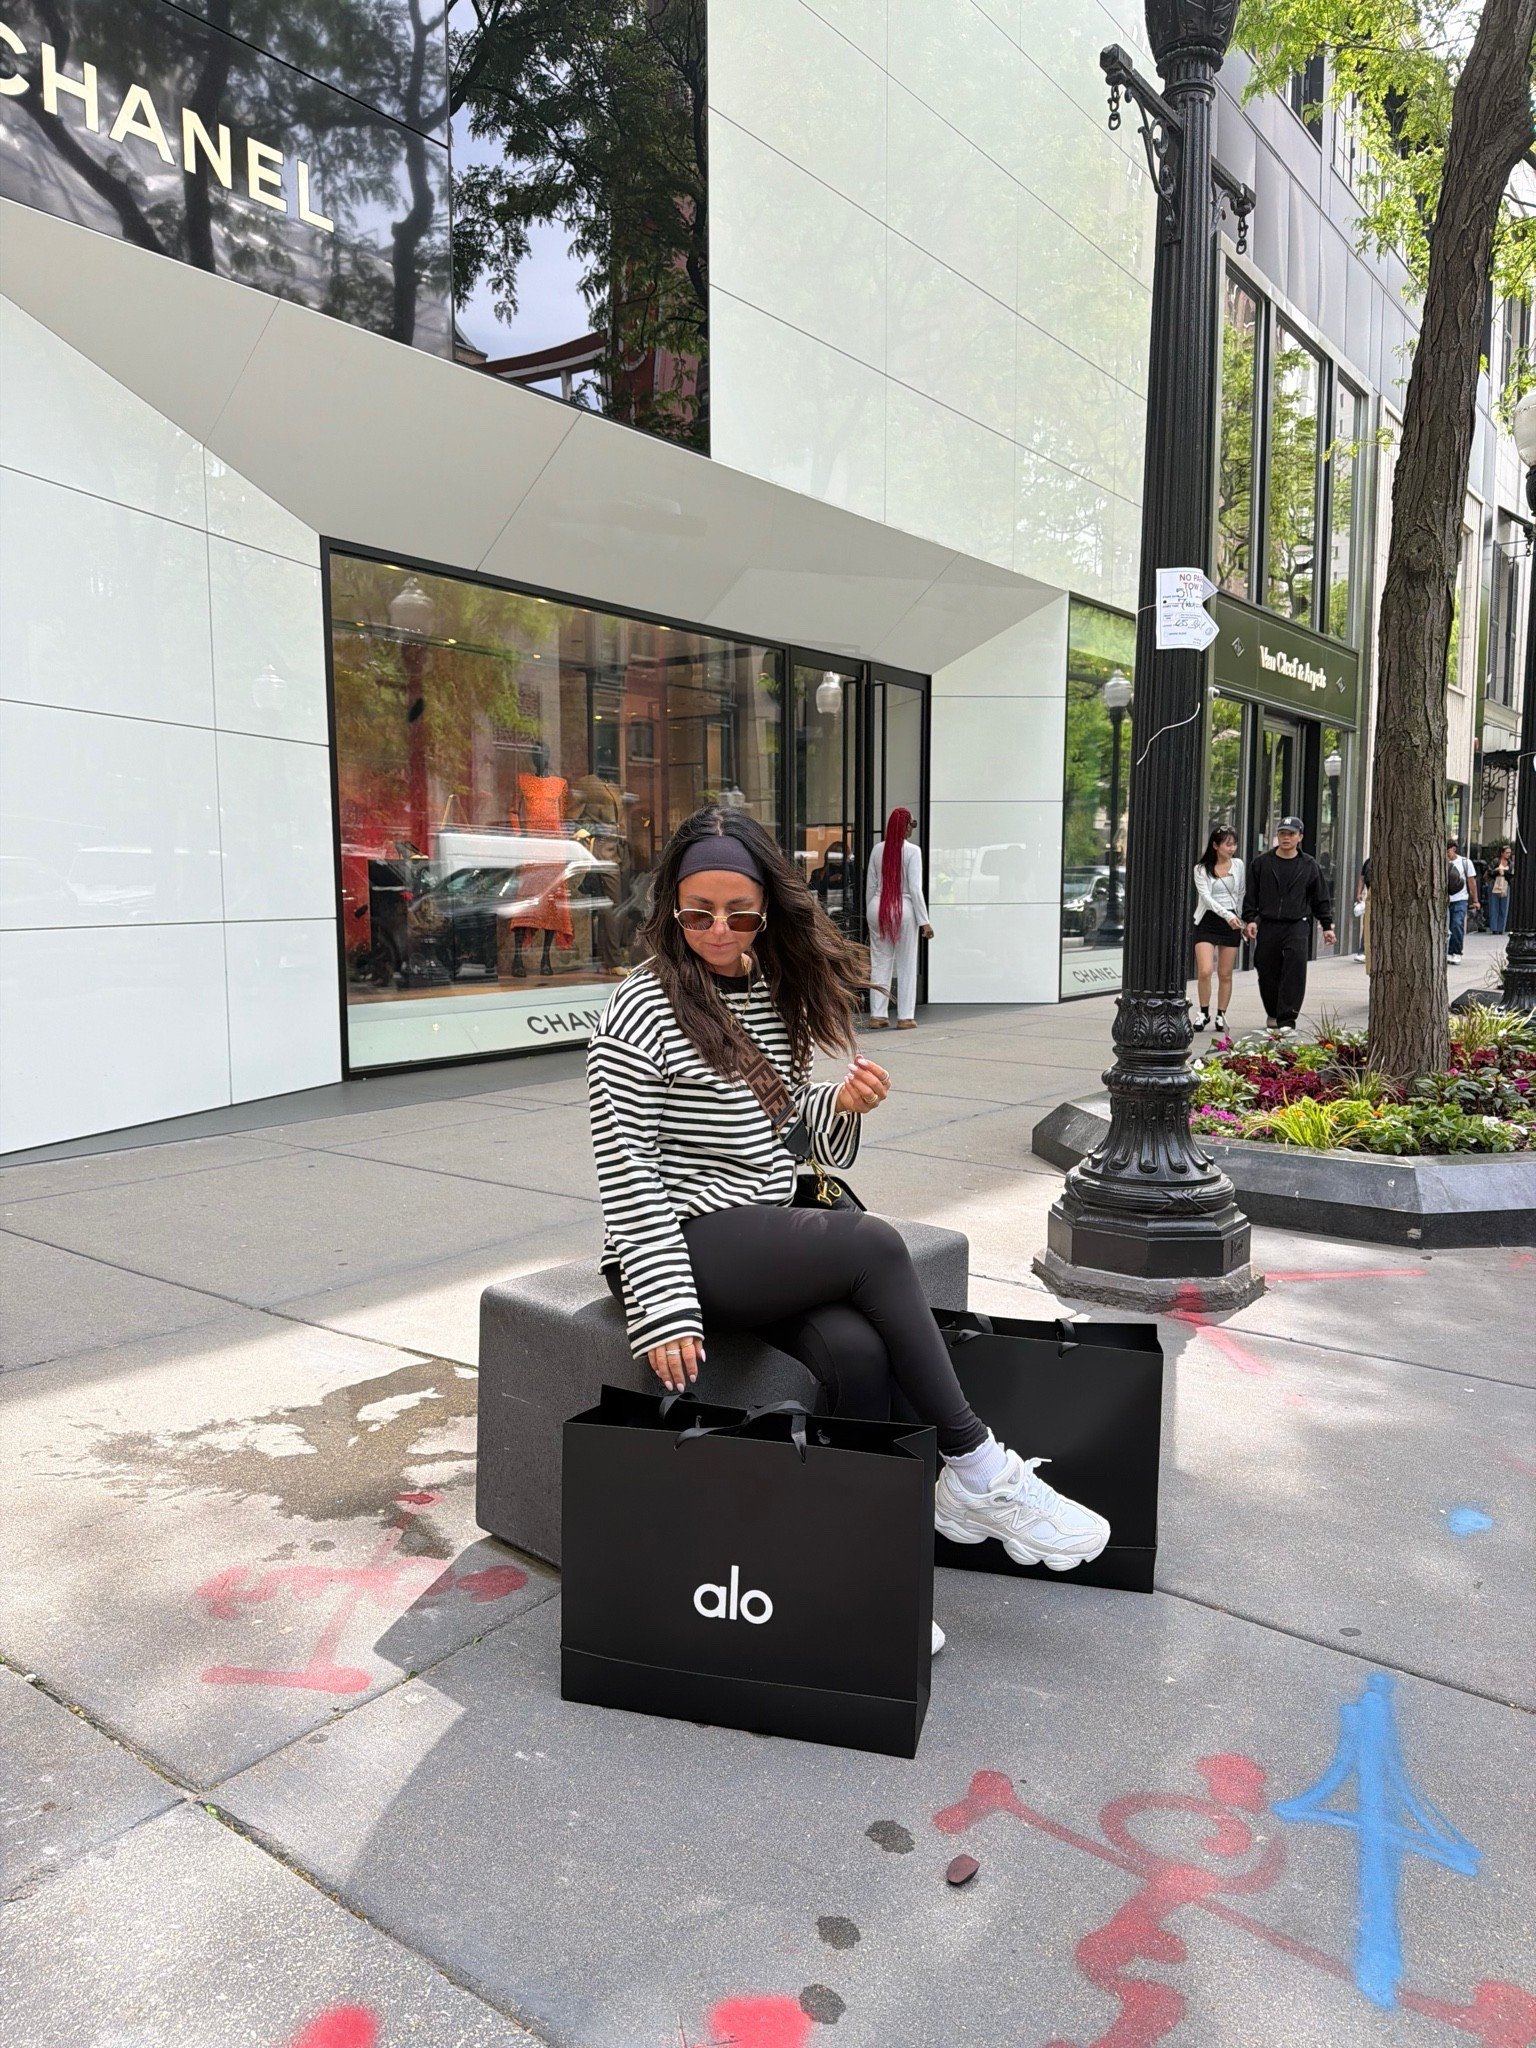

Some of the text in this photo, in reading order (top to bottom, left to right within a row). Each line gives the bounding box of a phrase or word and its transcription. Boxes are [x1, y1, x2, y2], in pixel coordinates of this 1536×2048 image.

[1179, 573, 1192, 582] NO
[1260, 645, 1276, 671] Van
[1276, 651, 1299, 678] Cleef
[1304, 662, 1327, 691] Arpels
[1072, 966, 1122, 983] CHANEL
[526, 1009, 605, 1035] CHAN
[693, 1565, 774, 1625] alo
